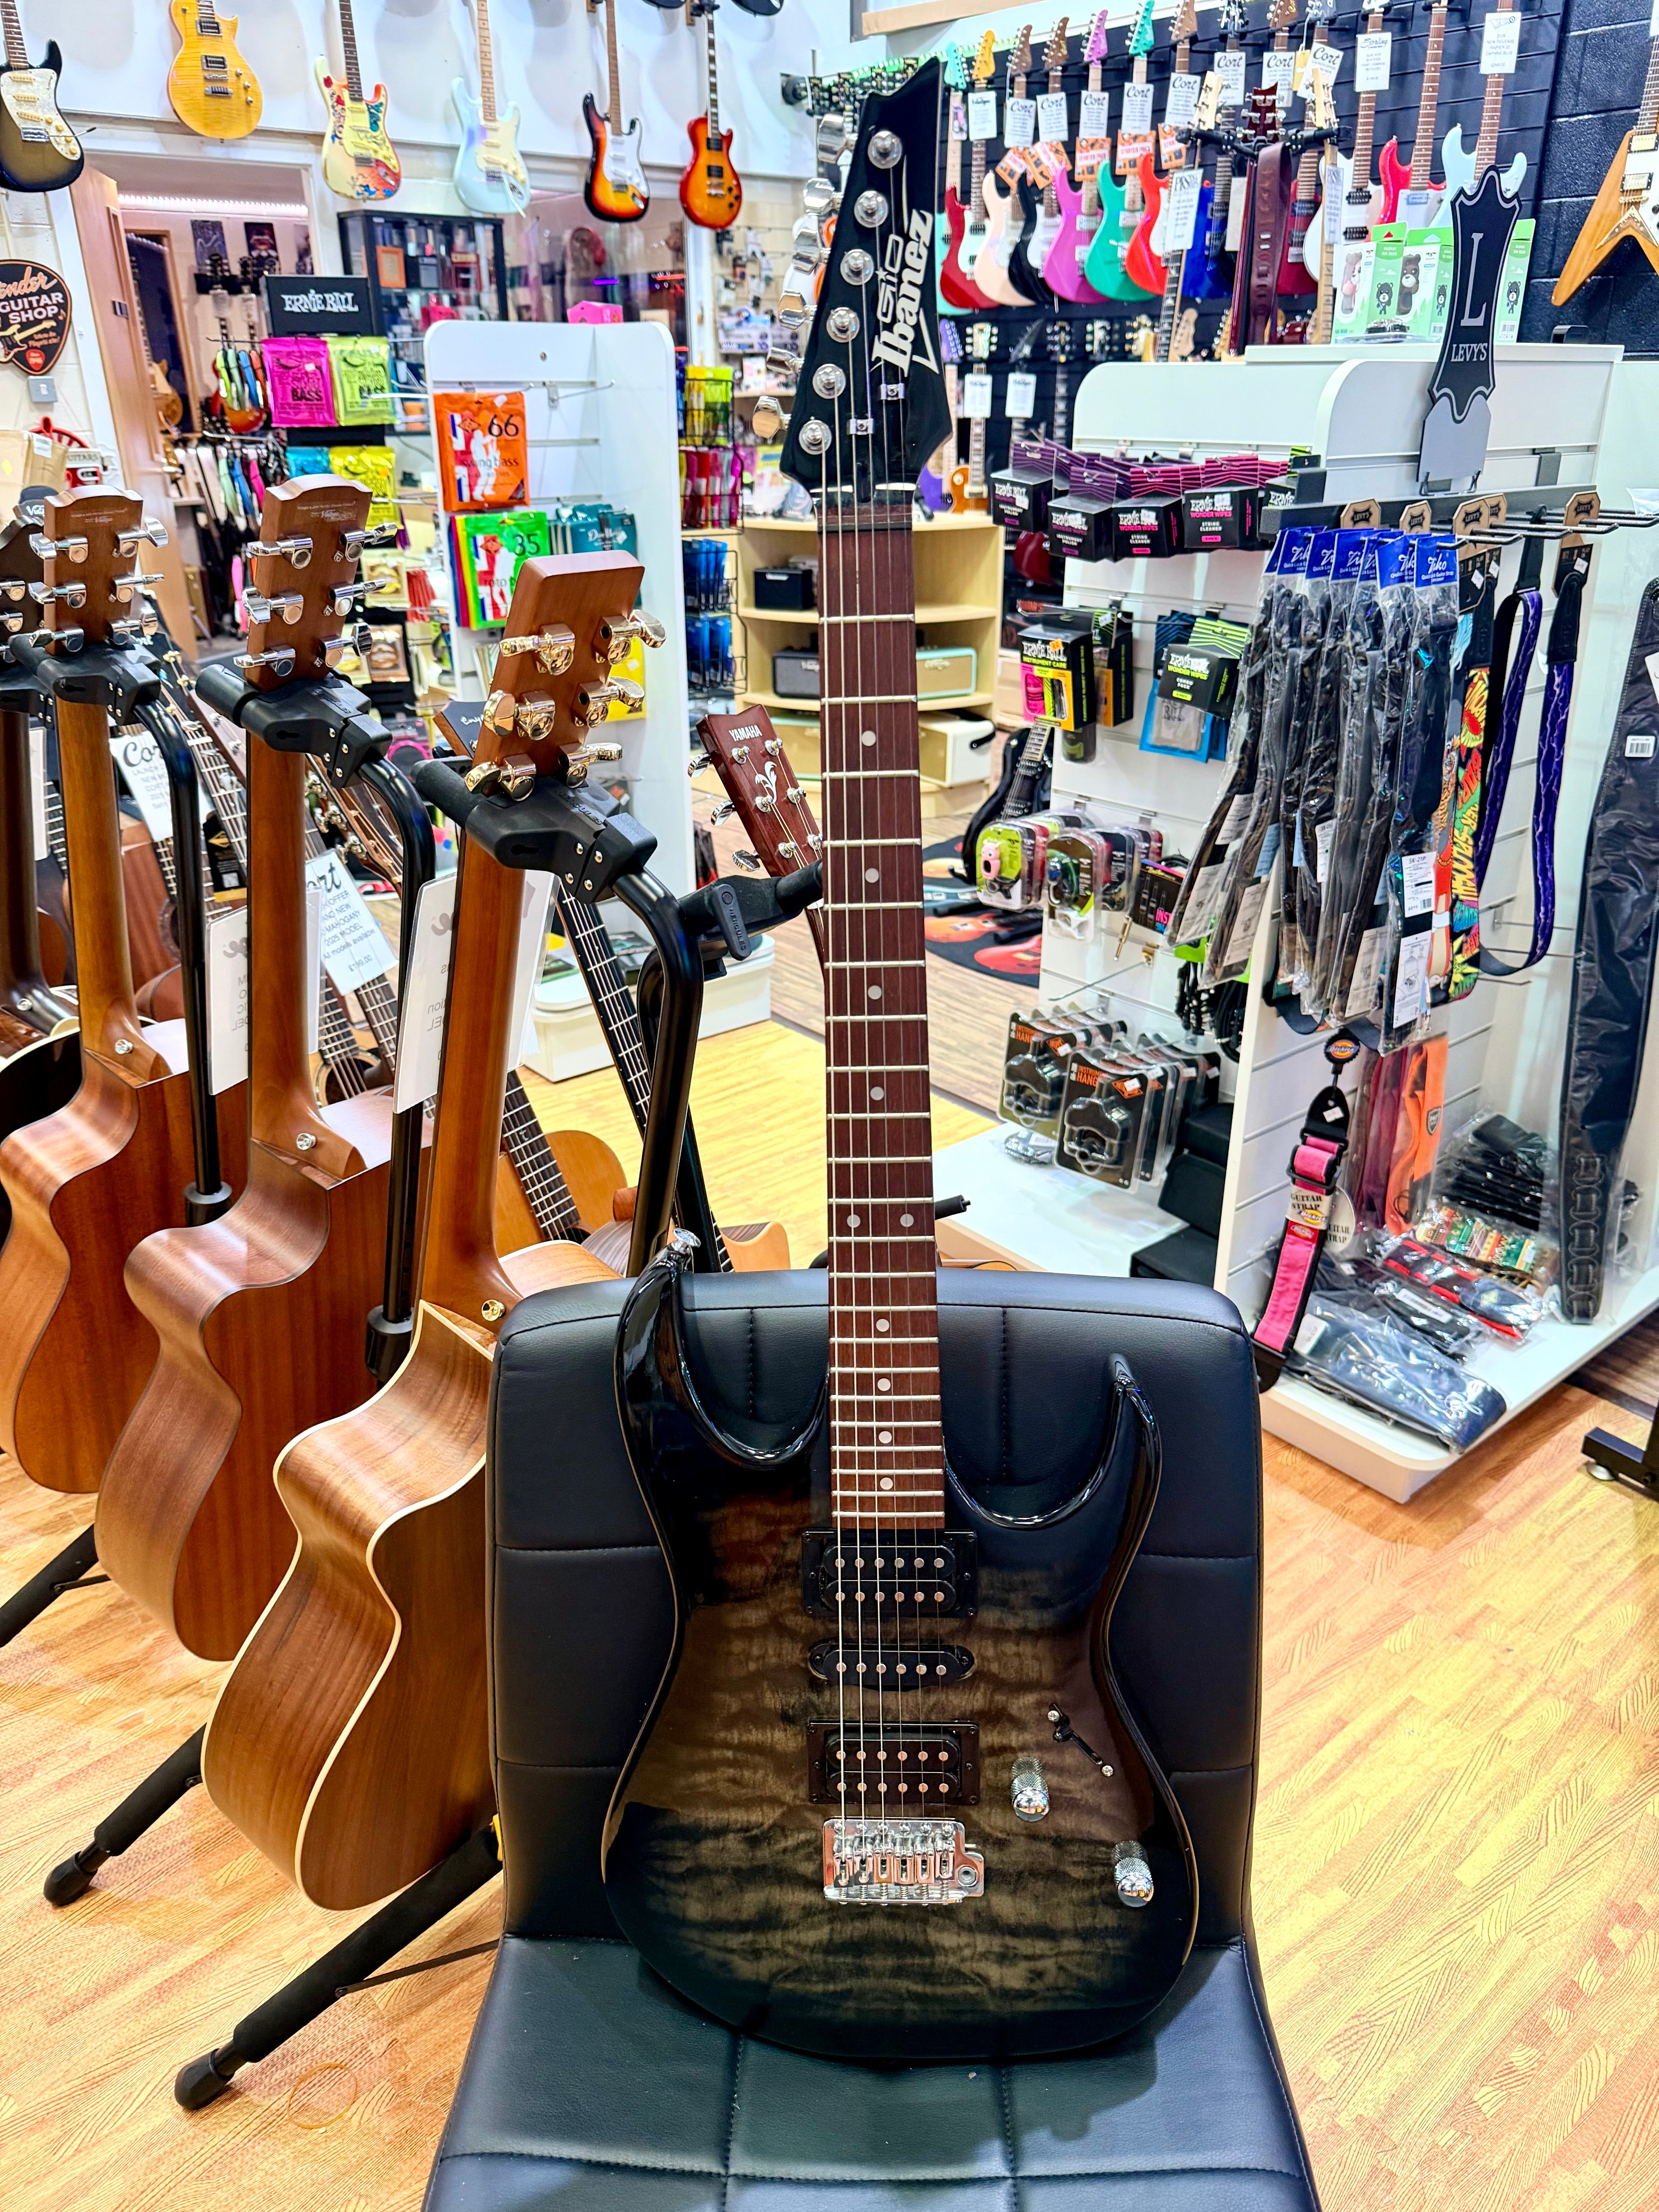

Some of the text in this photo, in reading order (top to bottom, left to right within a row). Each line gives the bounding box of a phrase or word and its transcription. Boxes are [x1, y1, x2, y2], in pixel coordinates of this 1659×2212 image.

[1217, 55, 1243, 68] Cort
[1267, 55, 1293, 69] Cort
[1313, 47, 1341, 65] Cort
[1172, 76, 1197, 90] Cort
[1127, 85, 1150, 98] Cort
[1011, 101, 1033, 113] Cort
[1041, 96, 1063, 110] Cort
[1084, 94, 1106, 106] Cort
[0, 266, 57, 299] ender
[871, 208, 933, 377] Ibanez
[0, 292, 64, 313] GUITAR
[325, 292, 359, 313] BALL
[9, 306, 58, 324] SHOP
[1451, 343, 1488, 362] LEVY'S
[488, 414, 519, 437] 66
[1023, 656, 1051, 666] INSTRUMENT
[1168, 665, 1209, 680] WONDER WIPES
[728, 725, 762, 741] YAMAHA
[328, 891, 350, 905] OFFER
[335, 903, 351, 913] NEW
[325, 923, 363, 946] 2025 MODEL
[332, 941, 352, 956] models
